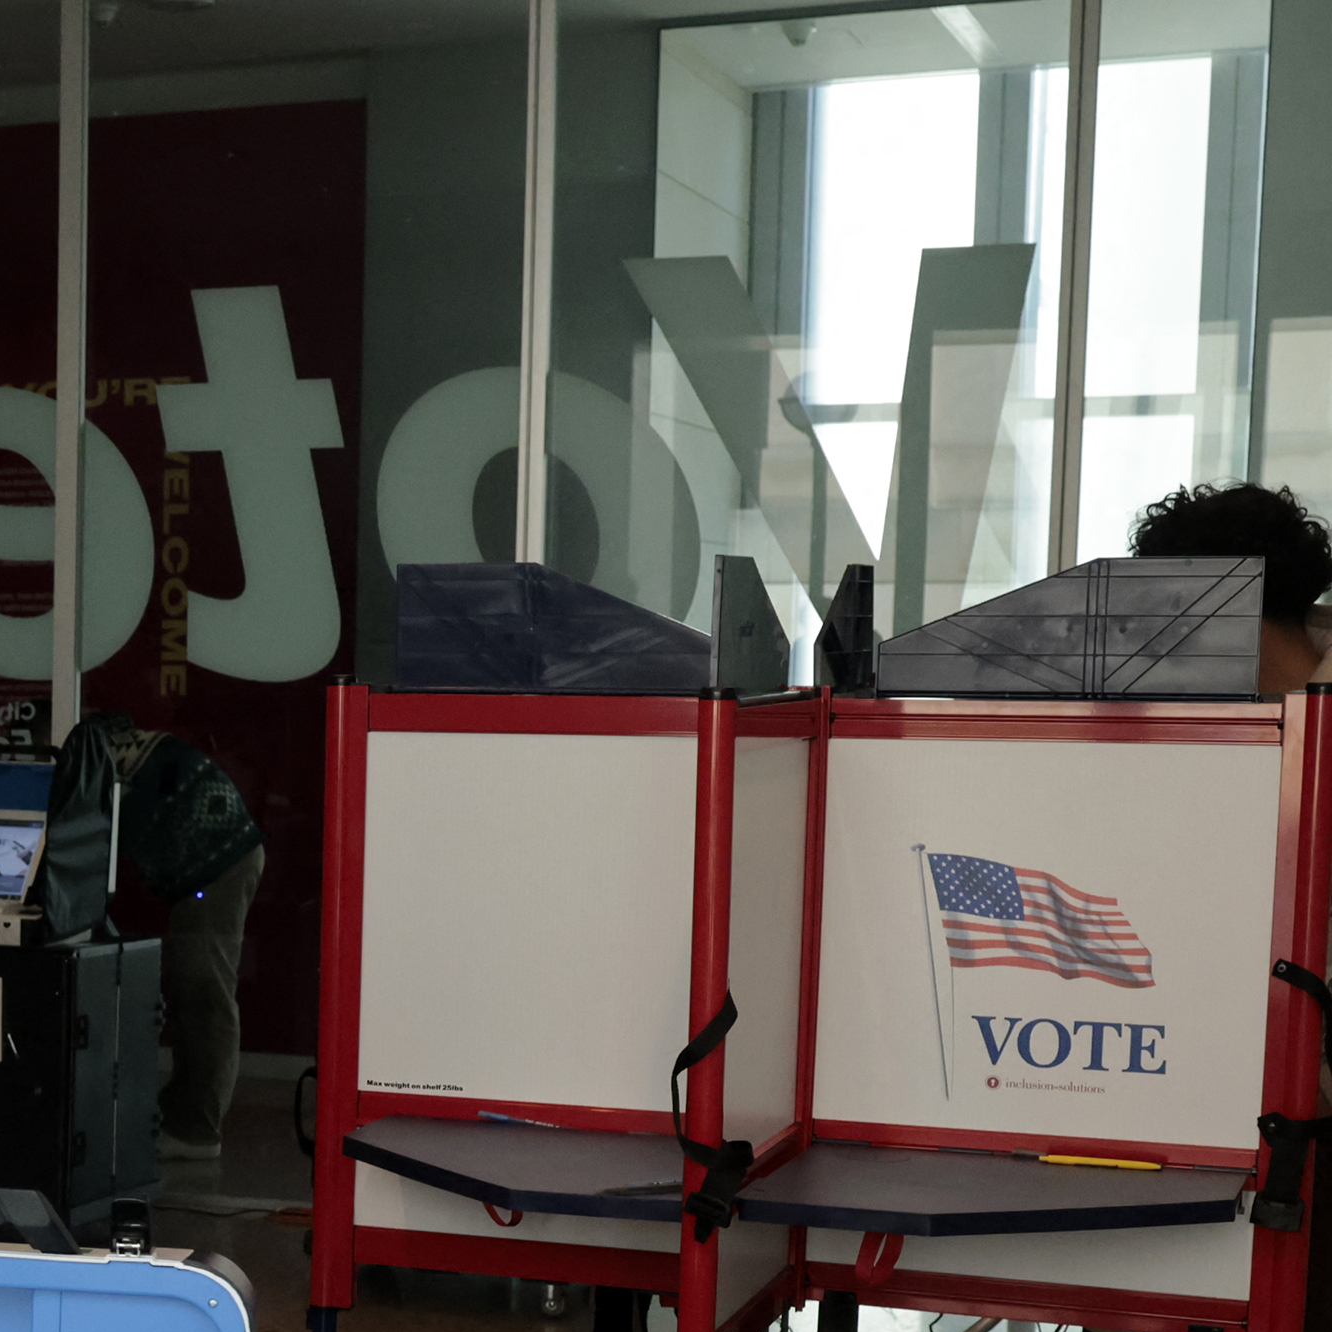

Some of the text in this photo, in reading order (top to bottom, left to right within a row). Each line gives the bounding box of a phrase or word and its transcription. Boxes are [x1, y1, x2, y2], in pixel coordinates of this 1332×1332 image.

[971, 1015, 1166, 1075] VOTE
[366, 1079, 383, 1087] Max
[384, 1081, 410, 1090] weight
[422, 1083, 441, 1091] shelf
[442, 1084, 464, 1092] 25lbs
[1005, 1078, 1106, 1095] inclusion-solutions
